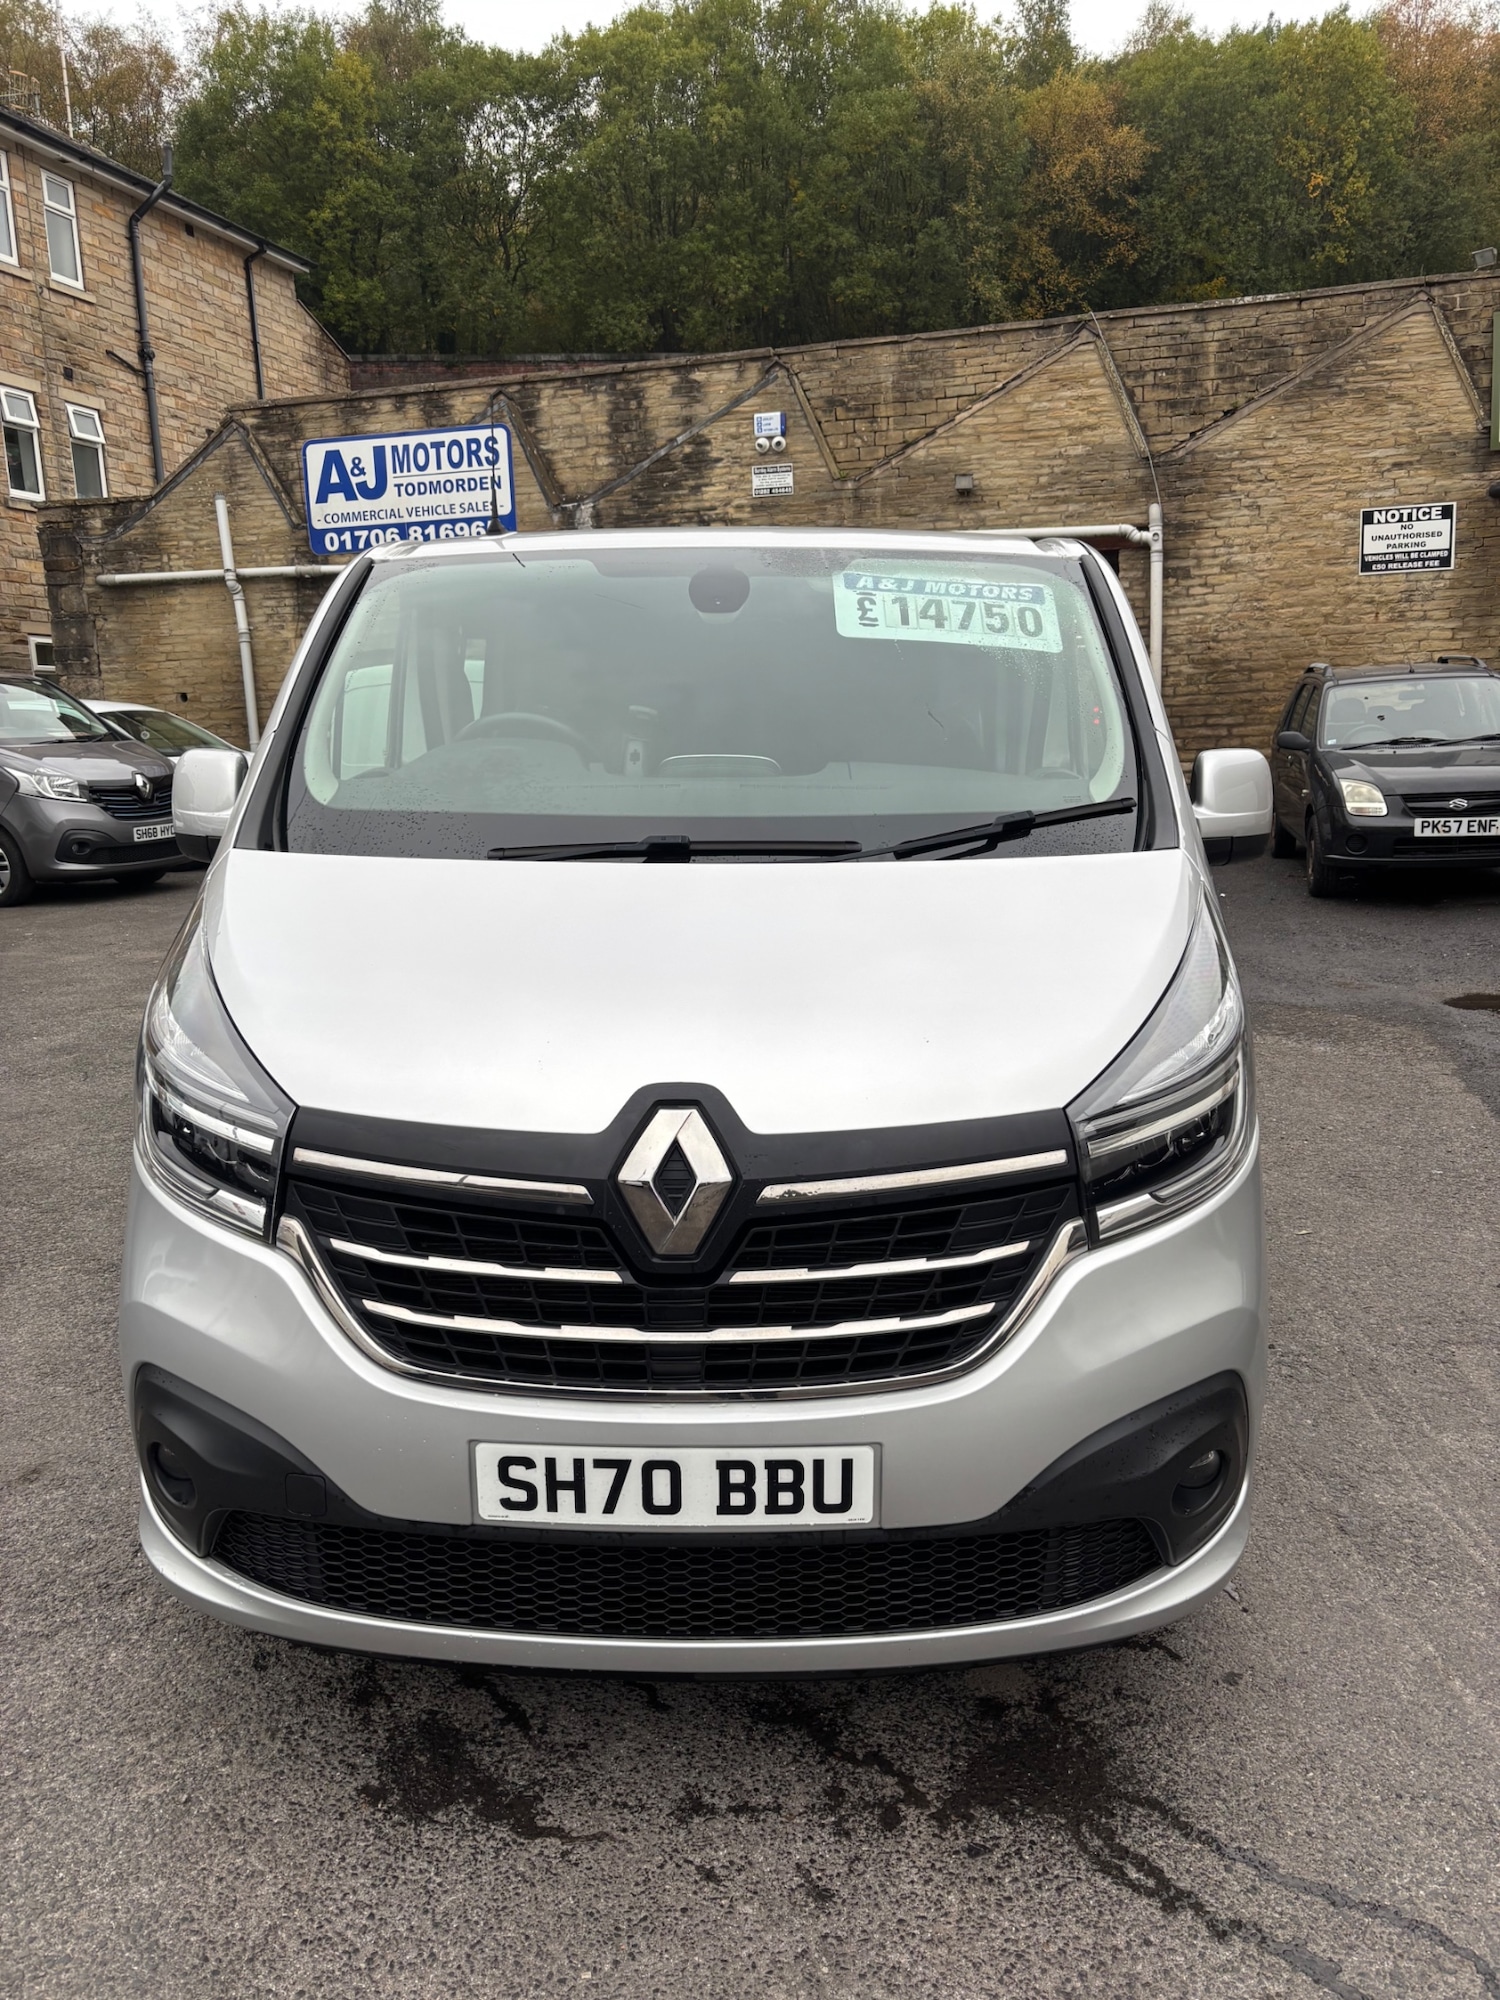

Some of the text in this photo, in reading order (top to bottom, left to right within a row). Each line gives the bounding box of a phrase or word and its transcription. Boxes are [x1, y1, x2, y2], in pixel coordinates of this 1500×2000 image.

[315, 436, 500, 504] A&J MOTORS
[394, 475, 502, 498] TODMORDEN
[324, 508, 404, 524] COMMERCIAL
[406, 503, 457, 518] VEHICLE
[1372, 506, 1443, 524] NOTICE
[324, 520, 491, 552] 01706 81696
[1371, 530, 1443, 542] UNAUTHORISED
[1386, 541, 1427, 550] PARKING
[1364, 554, 1394, 562] VEHICLES
[1394, 552, 1410, 561] WILL
[1420, 550, 1449, 558] CLAMPED
[1388, 560, 1424, 570] RELEASE
[855, 575, 1034, 601] A&J MOTORS
[136, 827, 158, 840] SH68
[1420, 819, 1498, 834] PK57 ENF
[497, 1455, 854, 1516] SH70 BBU
